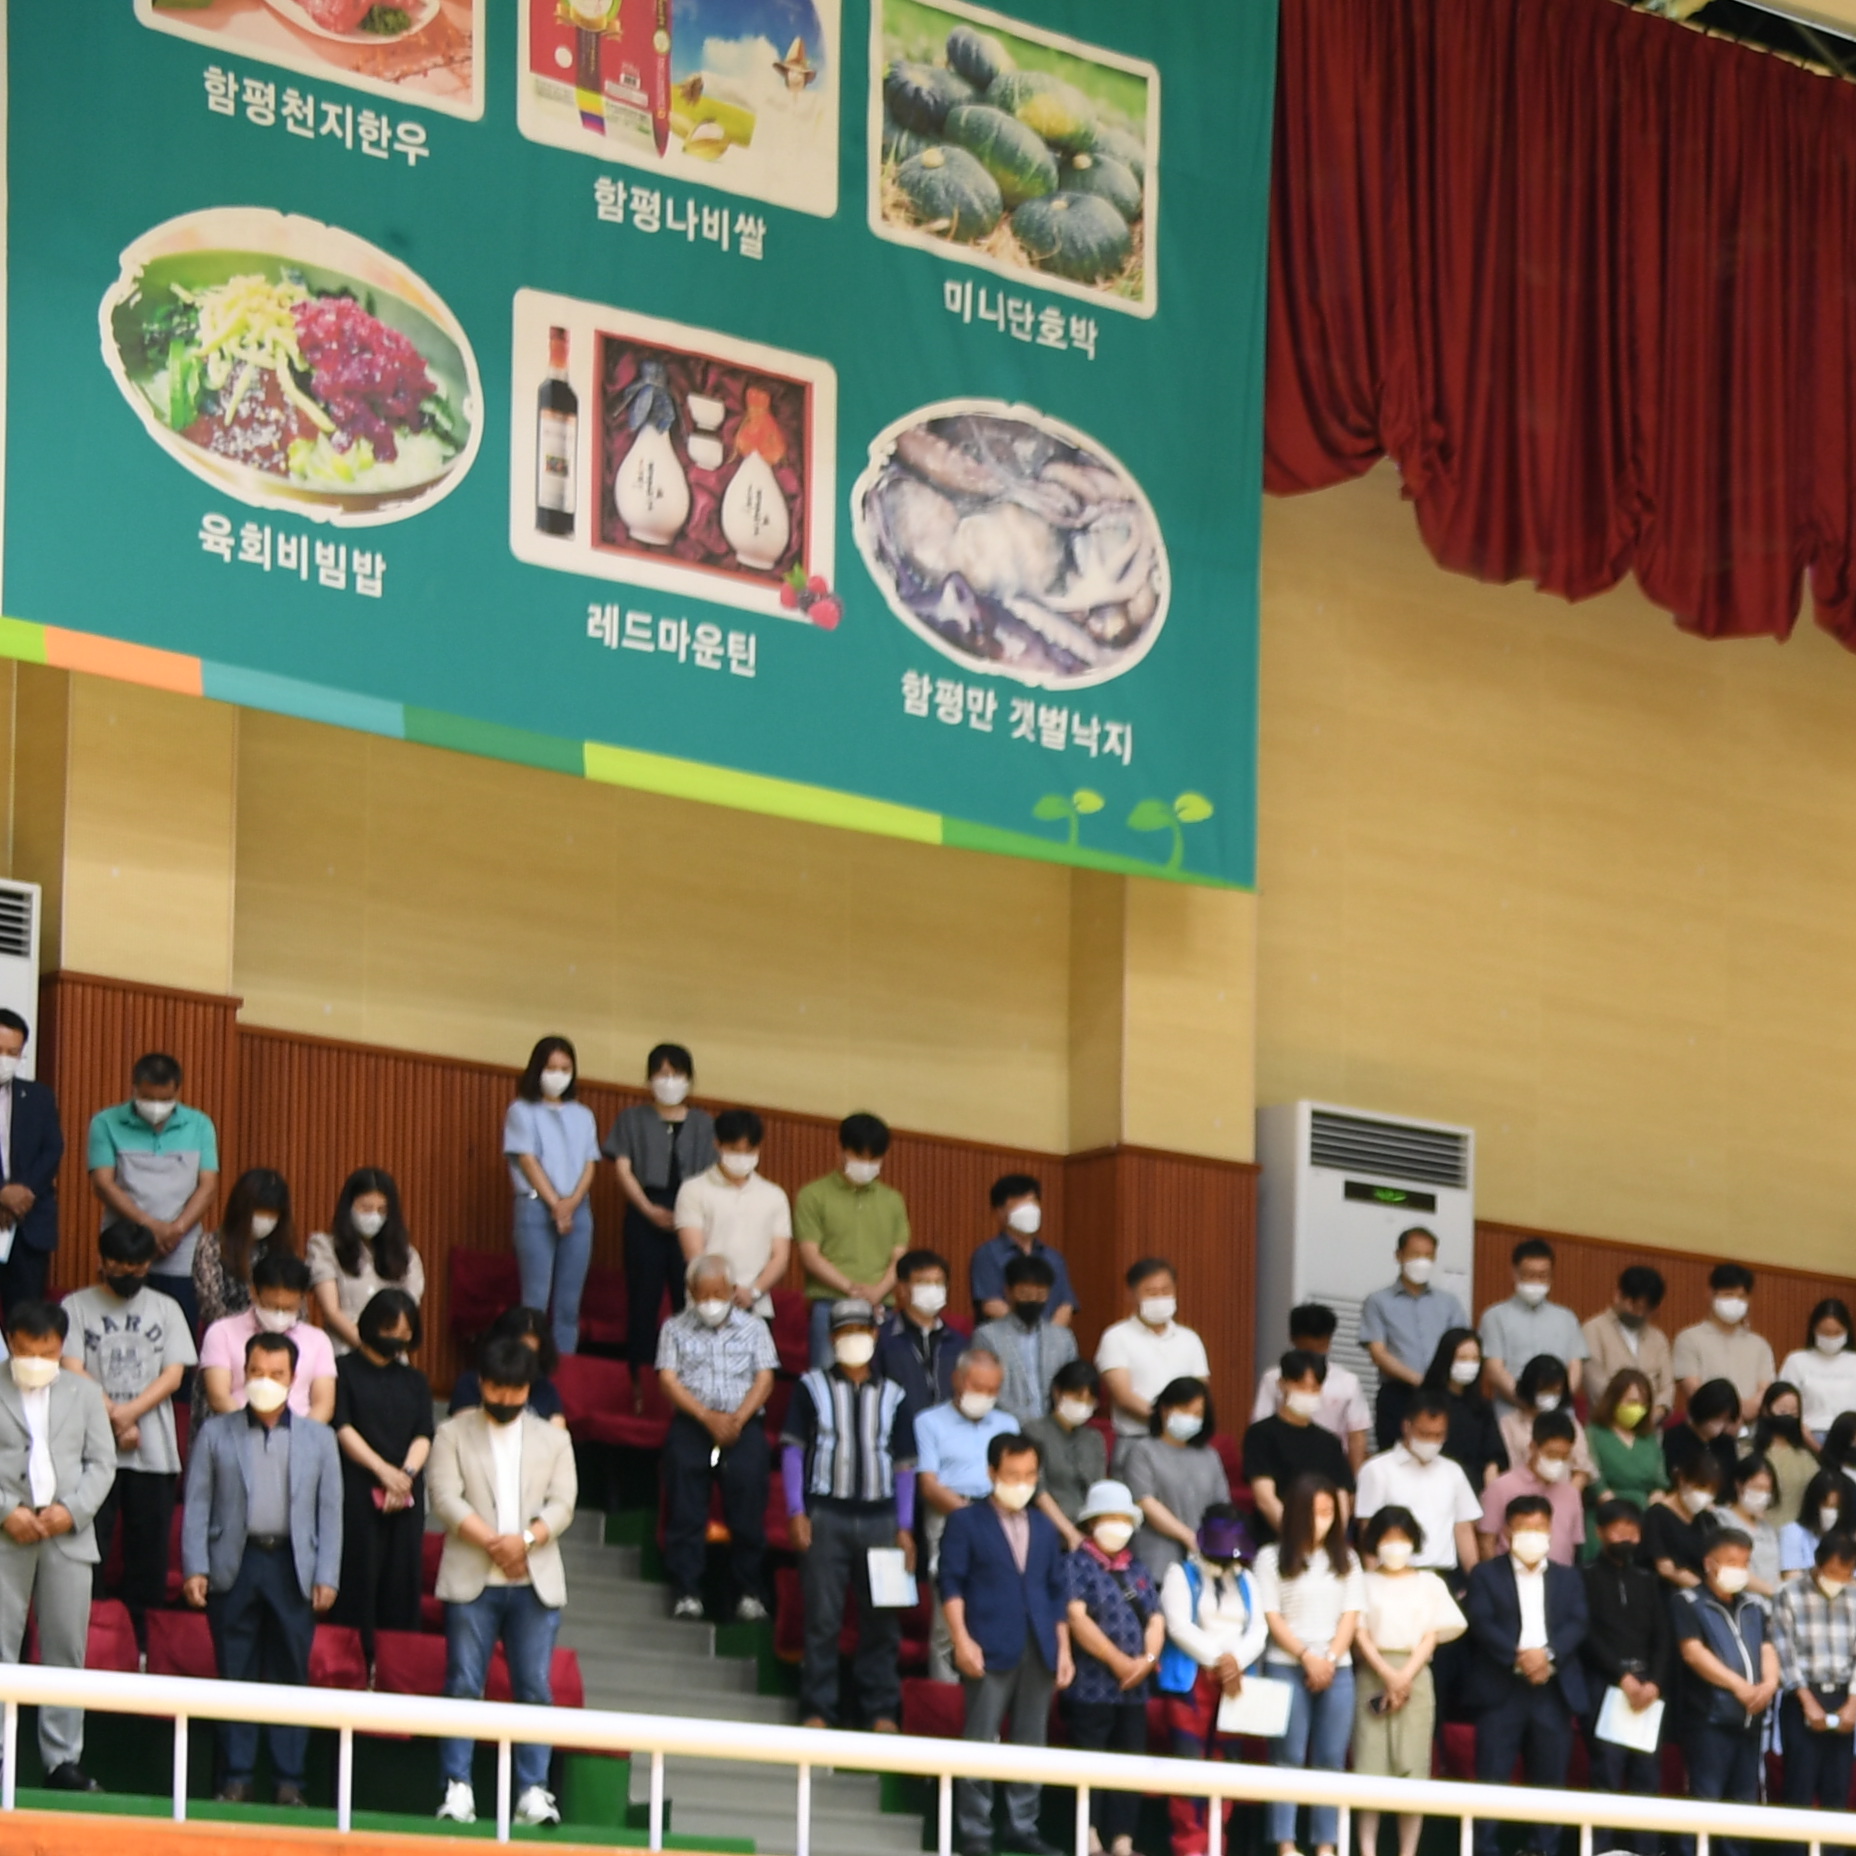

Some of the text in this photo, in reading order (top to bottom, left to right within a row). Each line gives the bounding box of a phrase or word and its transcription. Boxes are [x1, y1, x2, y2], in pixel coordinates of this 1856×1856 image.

[203, 65, 430, 167] 함평천지한우
[593, 176, 766, 261] 함평나비쌀
[943, 279, 1098, 361] 미니단호박
[198, 512, 387, 599] 육회비빔밥
[586, 602, 757, 678] 레드마운틴
[901, 668, 1133, 766] 함평만 갯벌낙지
